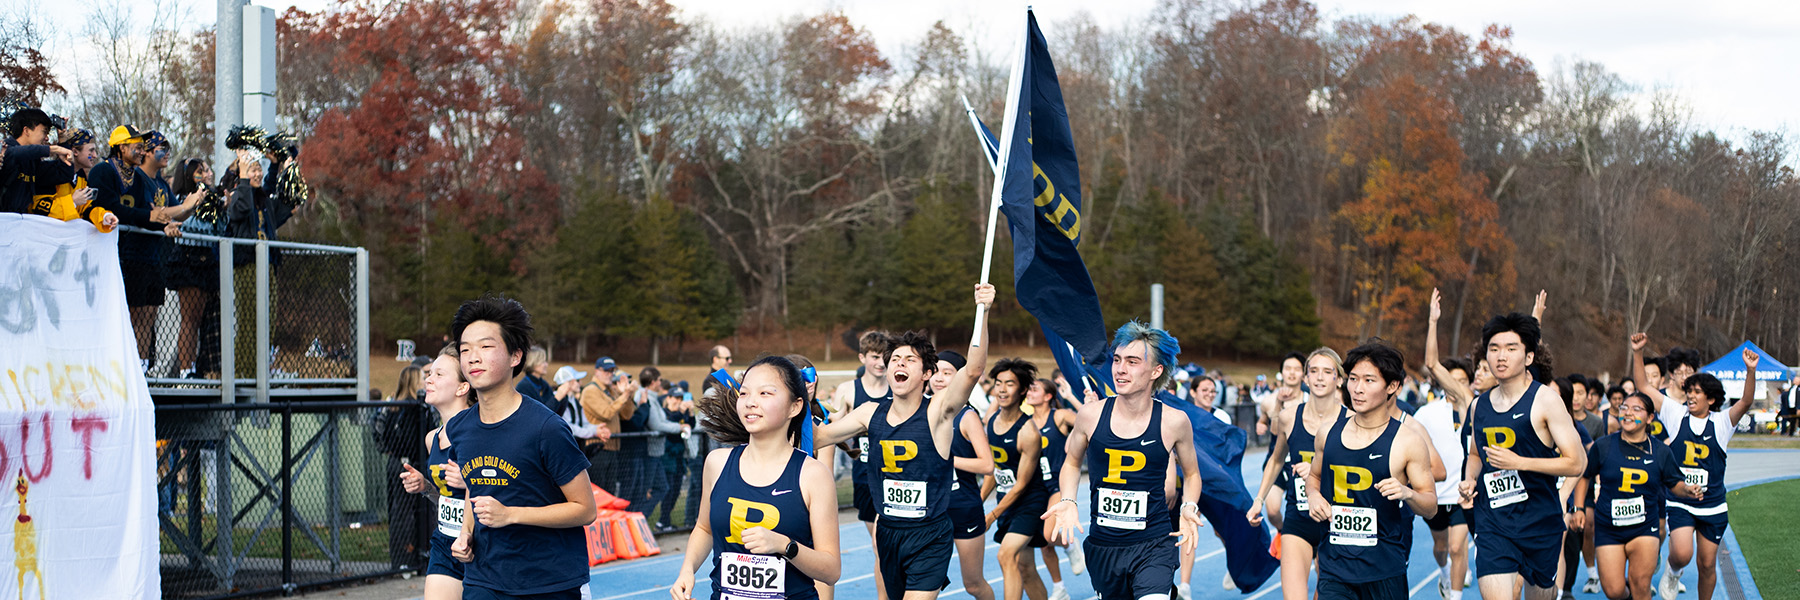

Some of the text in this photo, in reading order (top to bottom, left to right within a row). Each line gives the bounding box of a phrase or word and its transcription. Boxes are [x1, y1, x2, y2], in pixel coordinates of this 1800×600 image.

[396, 339, 416, 361] R
[1735, 370, 1782, 380] ACDEMY
[879, 440, 918, 473] P
[1683, 440, 1710, 466] P
[471, 456, 484, 469] AND
[484, 455, 499, 468] GOLD
[499, 459, 521, 479] GAMES
[1102, 447, 1147, 485] P
[470, 477, 509, 486] PEDDIE
[1329, 464, 1374, 504] P
[1489, 474, 1520, 494] 3972
[1618, 467, 1649, 493] P
[887, 487, 922, 504] 3987
[1102, 496, 1141, 515] 3971
[440, 504, 464, 523] 3943
[725, 496, 780, 545] P
[1614, 504, 1642, 516] 3869
[1334, 514, 1373, 532] 3982
[736, 554, 769, 566] MileSplit
[726, 563, 778, 589] 3952
